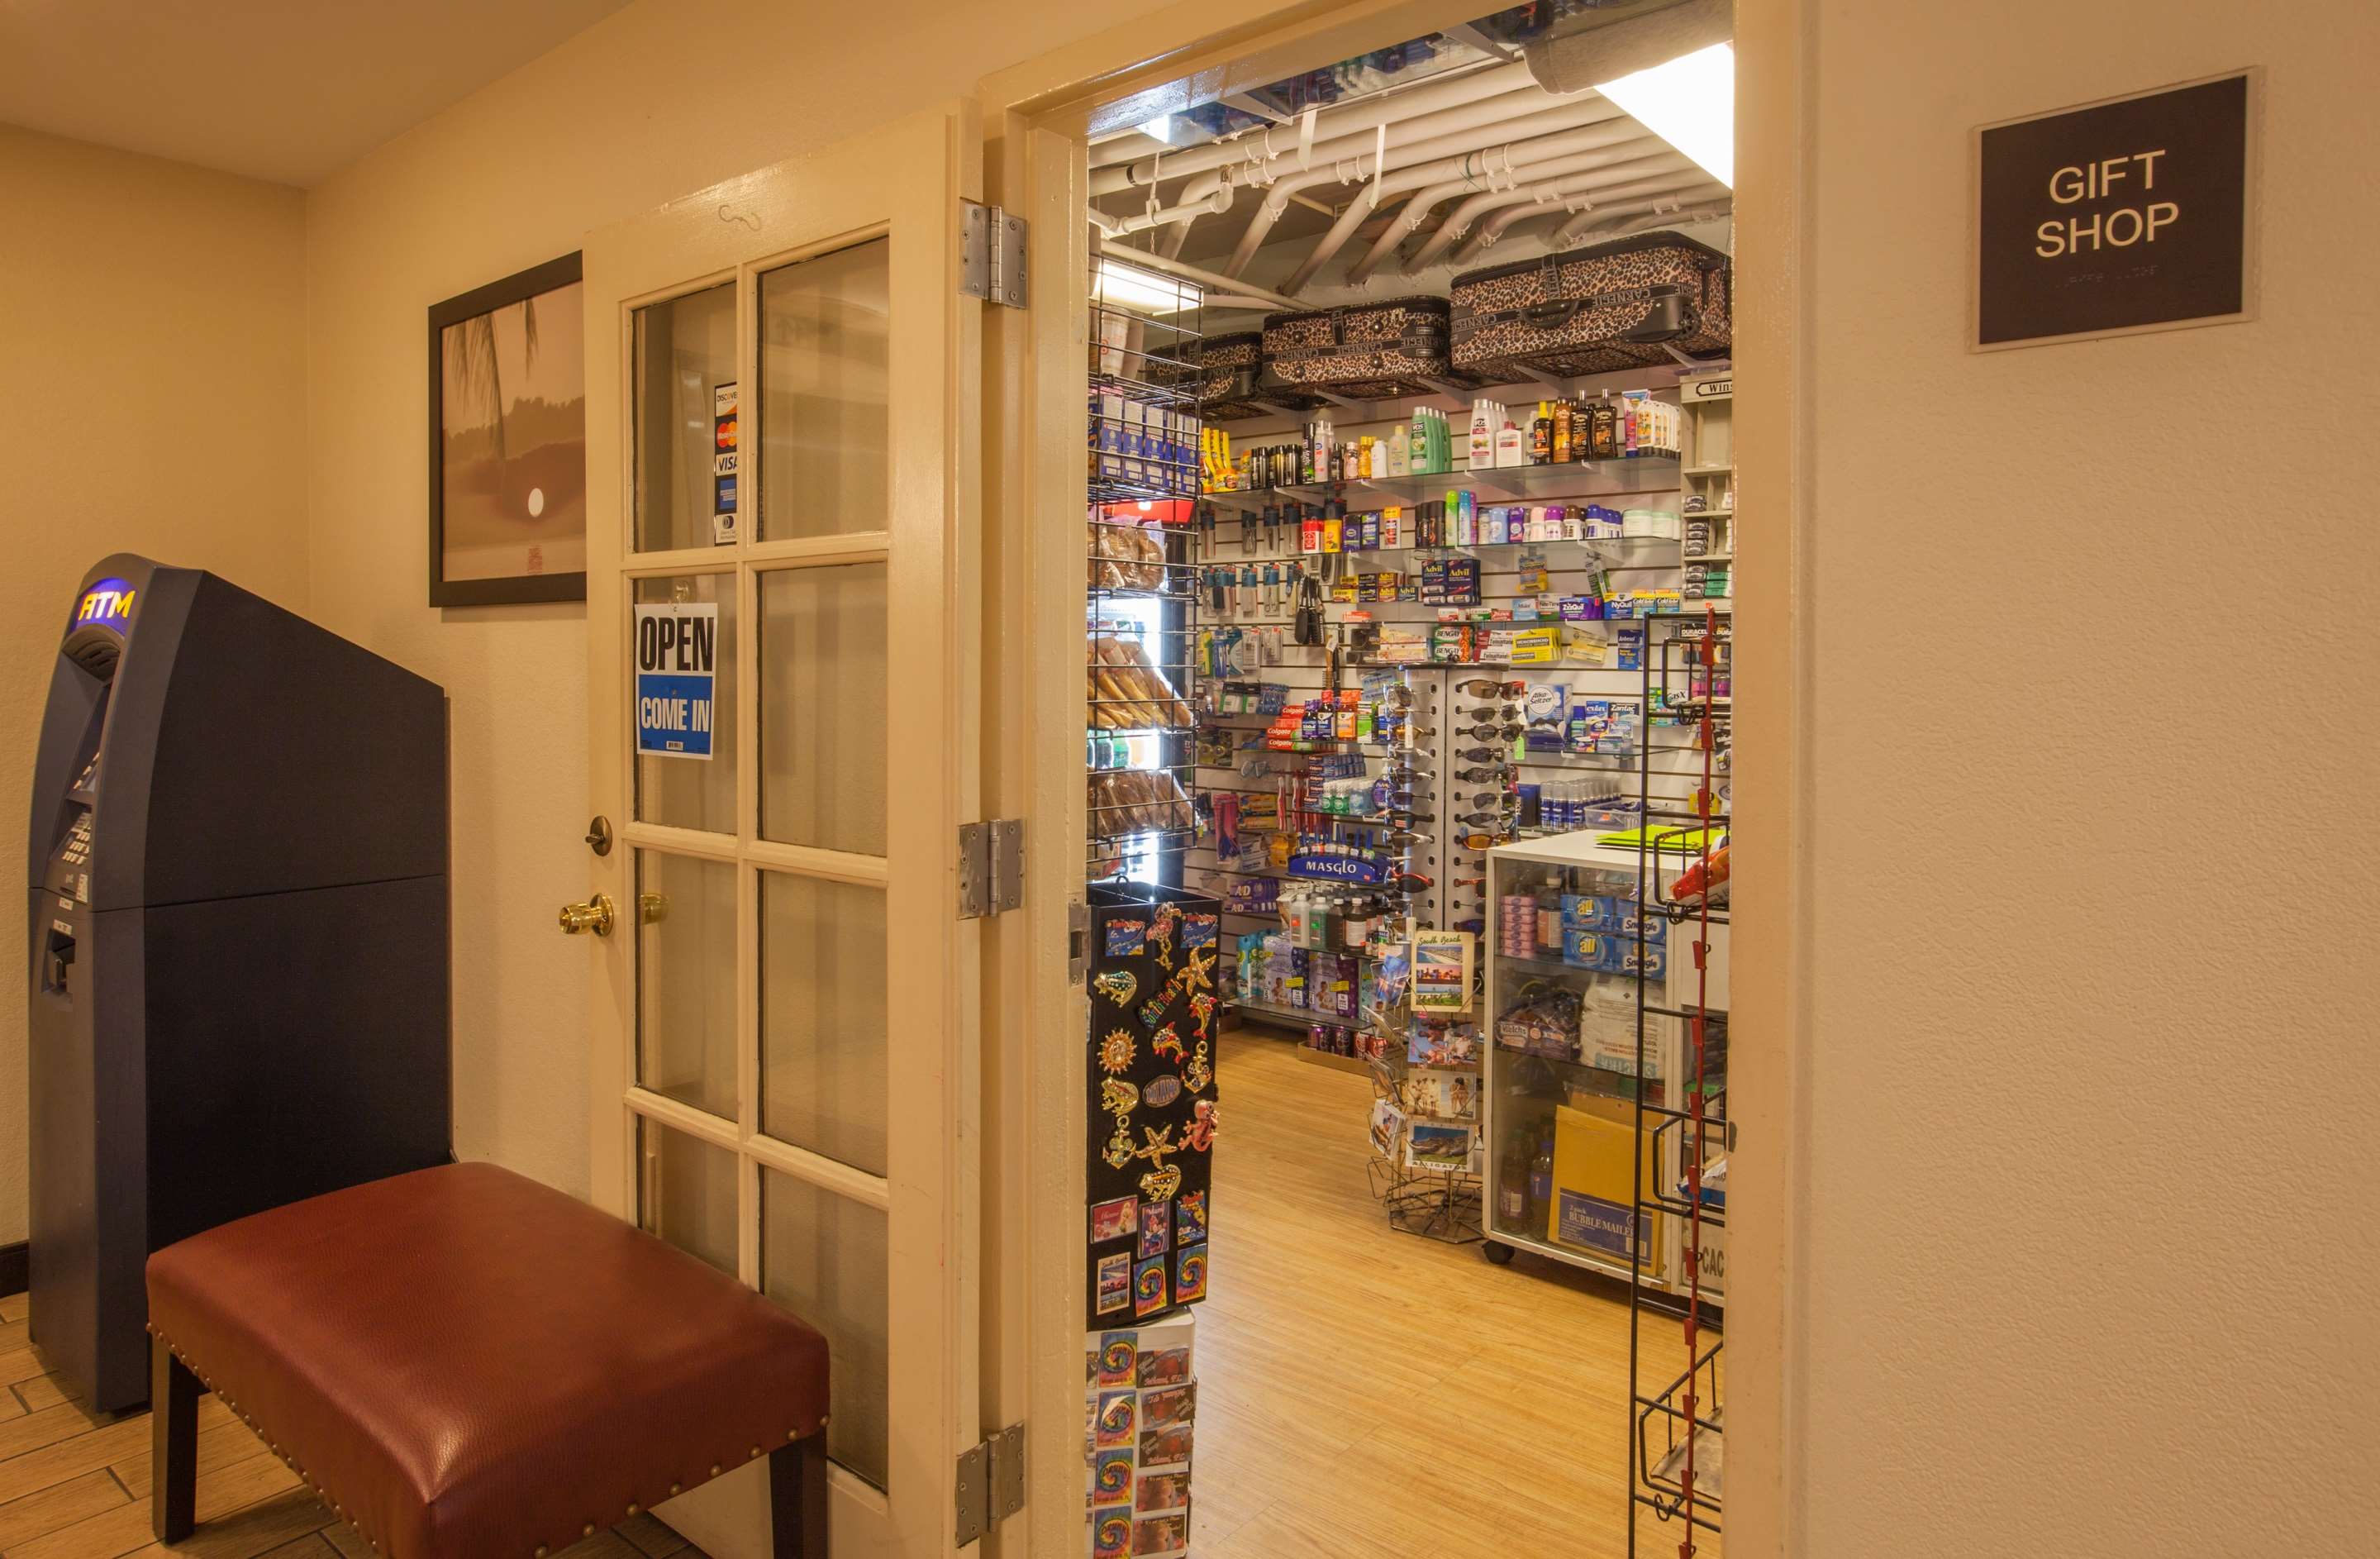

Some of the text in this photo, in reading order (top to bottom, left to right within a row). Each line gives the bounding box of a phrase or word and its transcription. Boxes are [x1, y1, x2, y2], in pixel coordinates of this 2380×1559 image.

[2049, 148, 2166, 205] GIFT
[2035, 202, 2180, 259] SHOP
[1592, 288, 1650, 308] CARNEGIE
[1276, 349, 1319, 361] CARNEGIE
[1336, 342, 1383, 355] CARNEGIE
[1425, 565, 1442, 573] Advil
[1449, 568, 1469, 577] Advil
[78, 590, 136, 621] ATM
[1611, 602, 1632, 610] NyQuil
[1436, 629, 1459, 637] BENGAY
[640, 616, 714, 671] OPEN
[1282, 707, 1305, 715] Colgate
[1611, 703, 1635, 712] Zantac
[640, 697, 710, 732] COME IN
[1267, 727, 1292, 736] Colgate
[1269, 739, 1292, 747] Colgate
[1626, 919, 1657, 932] Sngle
[1418, 935, 1461, 946] South Beach
[1579, 938, 1597, 953] all
[1626, 957, 1657, 970] Sngle
[1568, 1211, 1602, 1231] BUBBLE
